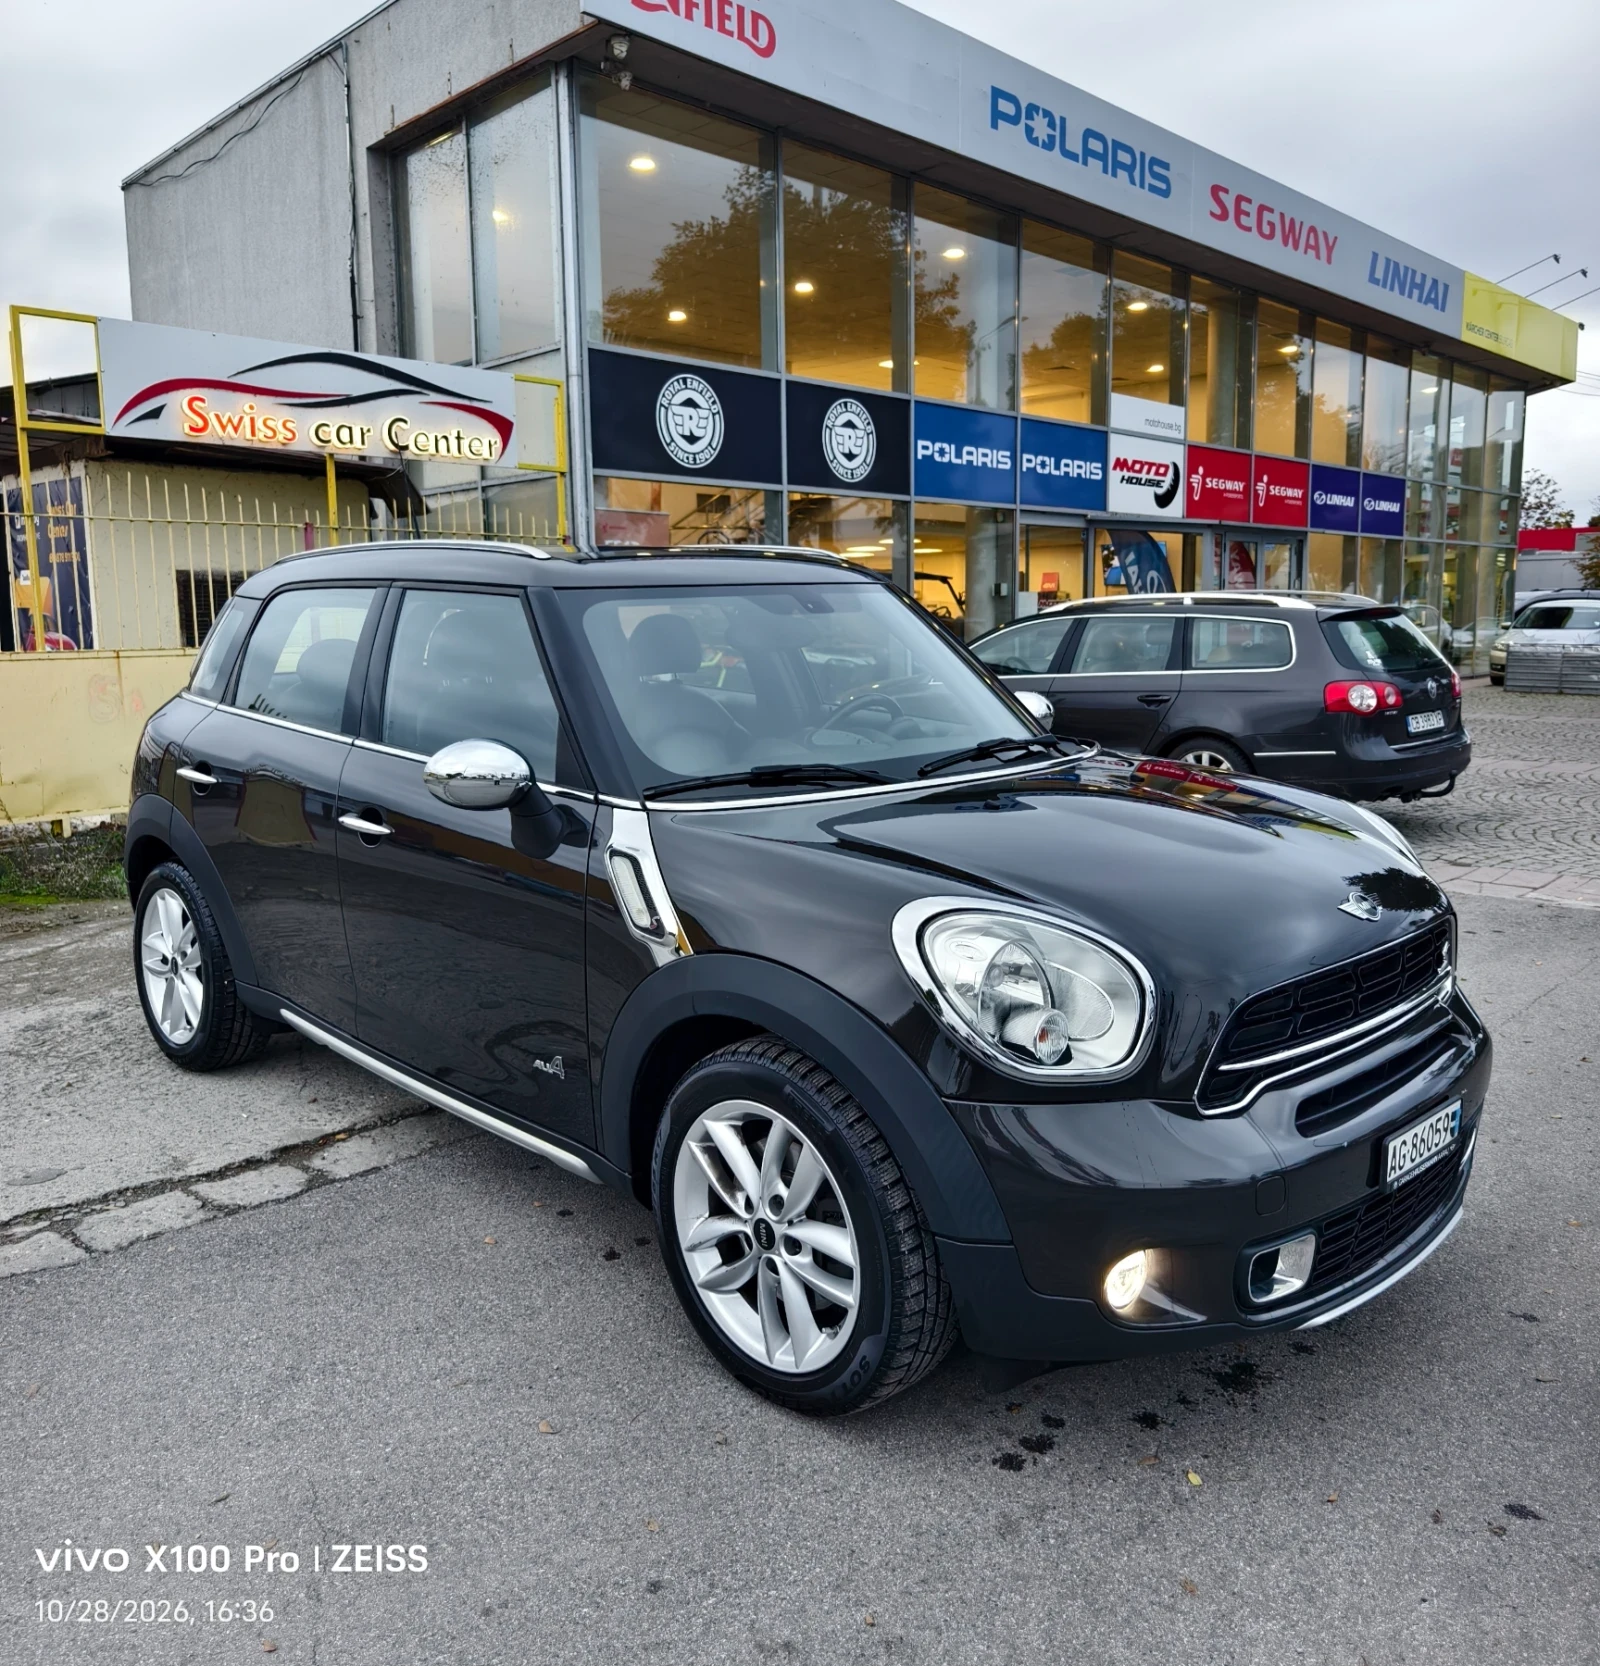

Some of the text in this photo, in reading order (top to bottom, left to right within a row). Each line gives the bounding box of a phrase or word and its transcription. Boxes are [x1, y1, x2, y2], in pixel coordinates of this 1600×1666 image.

[990, 84, 1172, 199] POLARIS
[1209, 183, 1339, 266] SEGWAY
[1368, 251, 1450, 313] LINHAI
[661, 378, 719, 413] ROYAL ENFIELD
[181, 395, 500, 460] Swiss car Center
[826, 401, 872, 434] ROYAL ENFIELD
[1144, 417, 1182, 434] motohouse.bg
[668, 441, 715, 464] SINCE 1901
[917, 439, 1011, 470] POLARIS
[831, 459, 869, 479] SINCE 1901
[1022, 453, 1102, 480] POLARIS
[1112, 457, 1170, 477] MOTO
[1120, 475, 1165, 488] HOUSE
[1205, 477, 1245, 492] SEGWAY
[1269, 485, 1303, 498] SEGWAY
[1326, 493, 1355, 507] LINHAI
[1375, 499, 1400, 513] LINHAI
[759, 1222, 769, 1248] MINI
